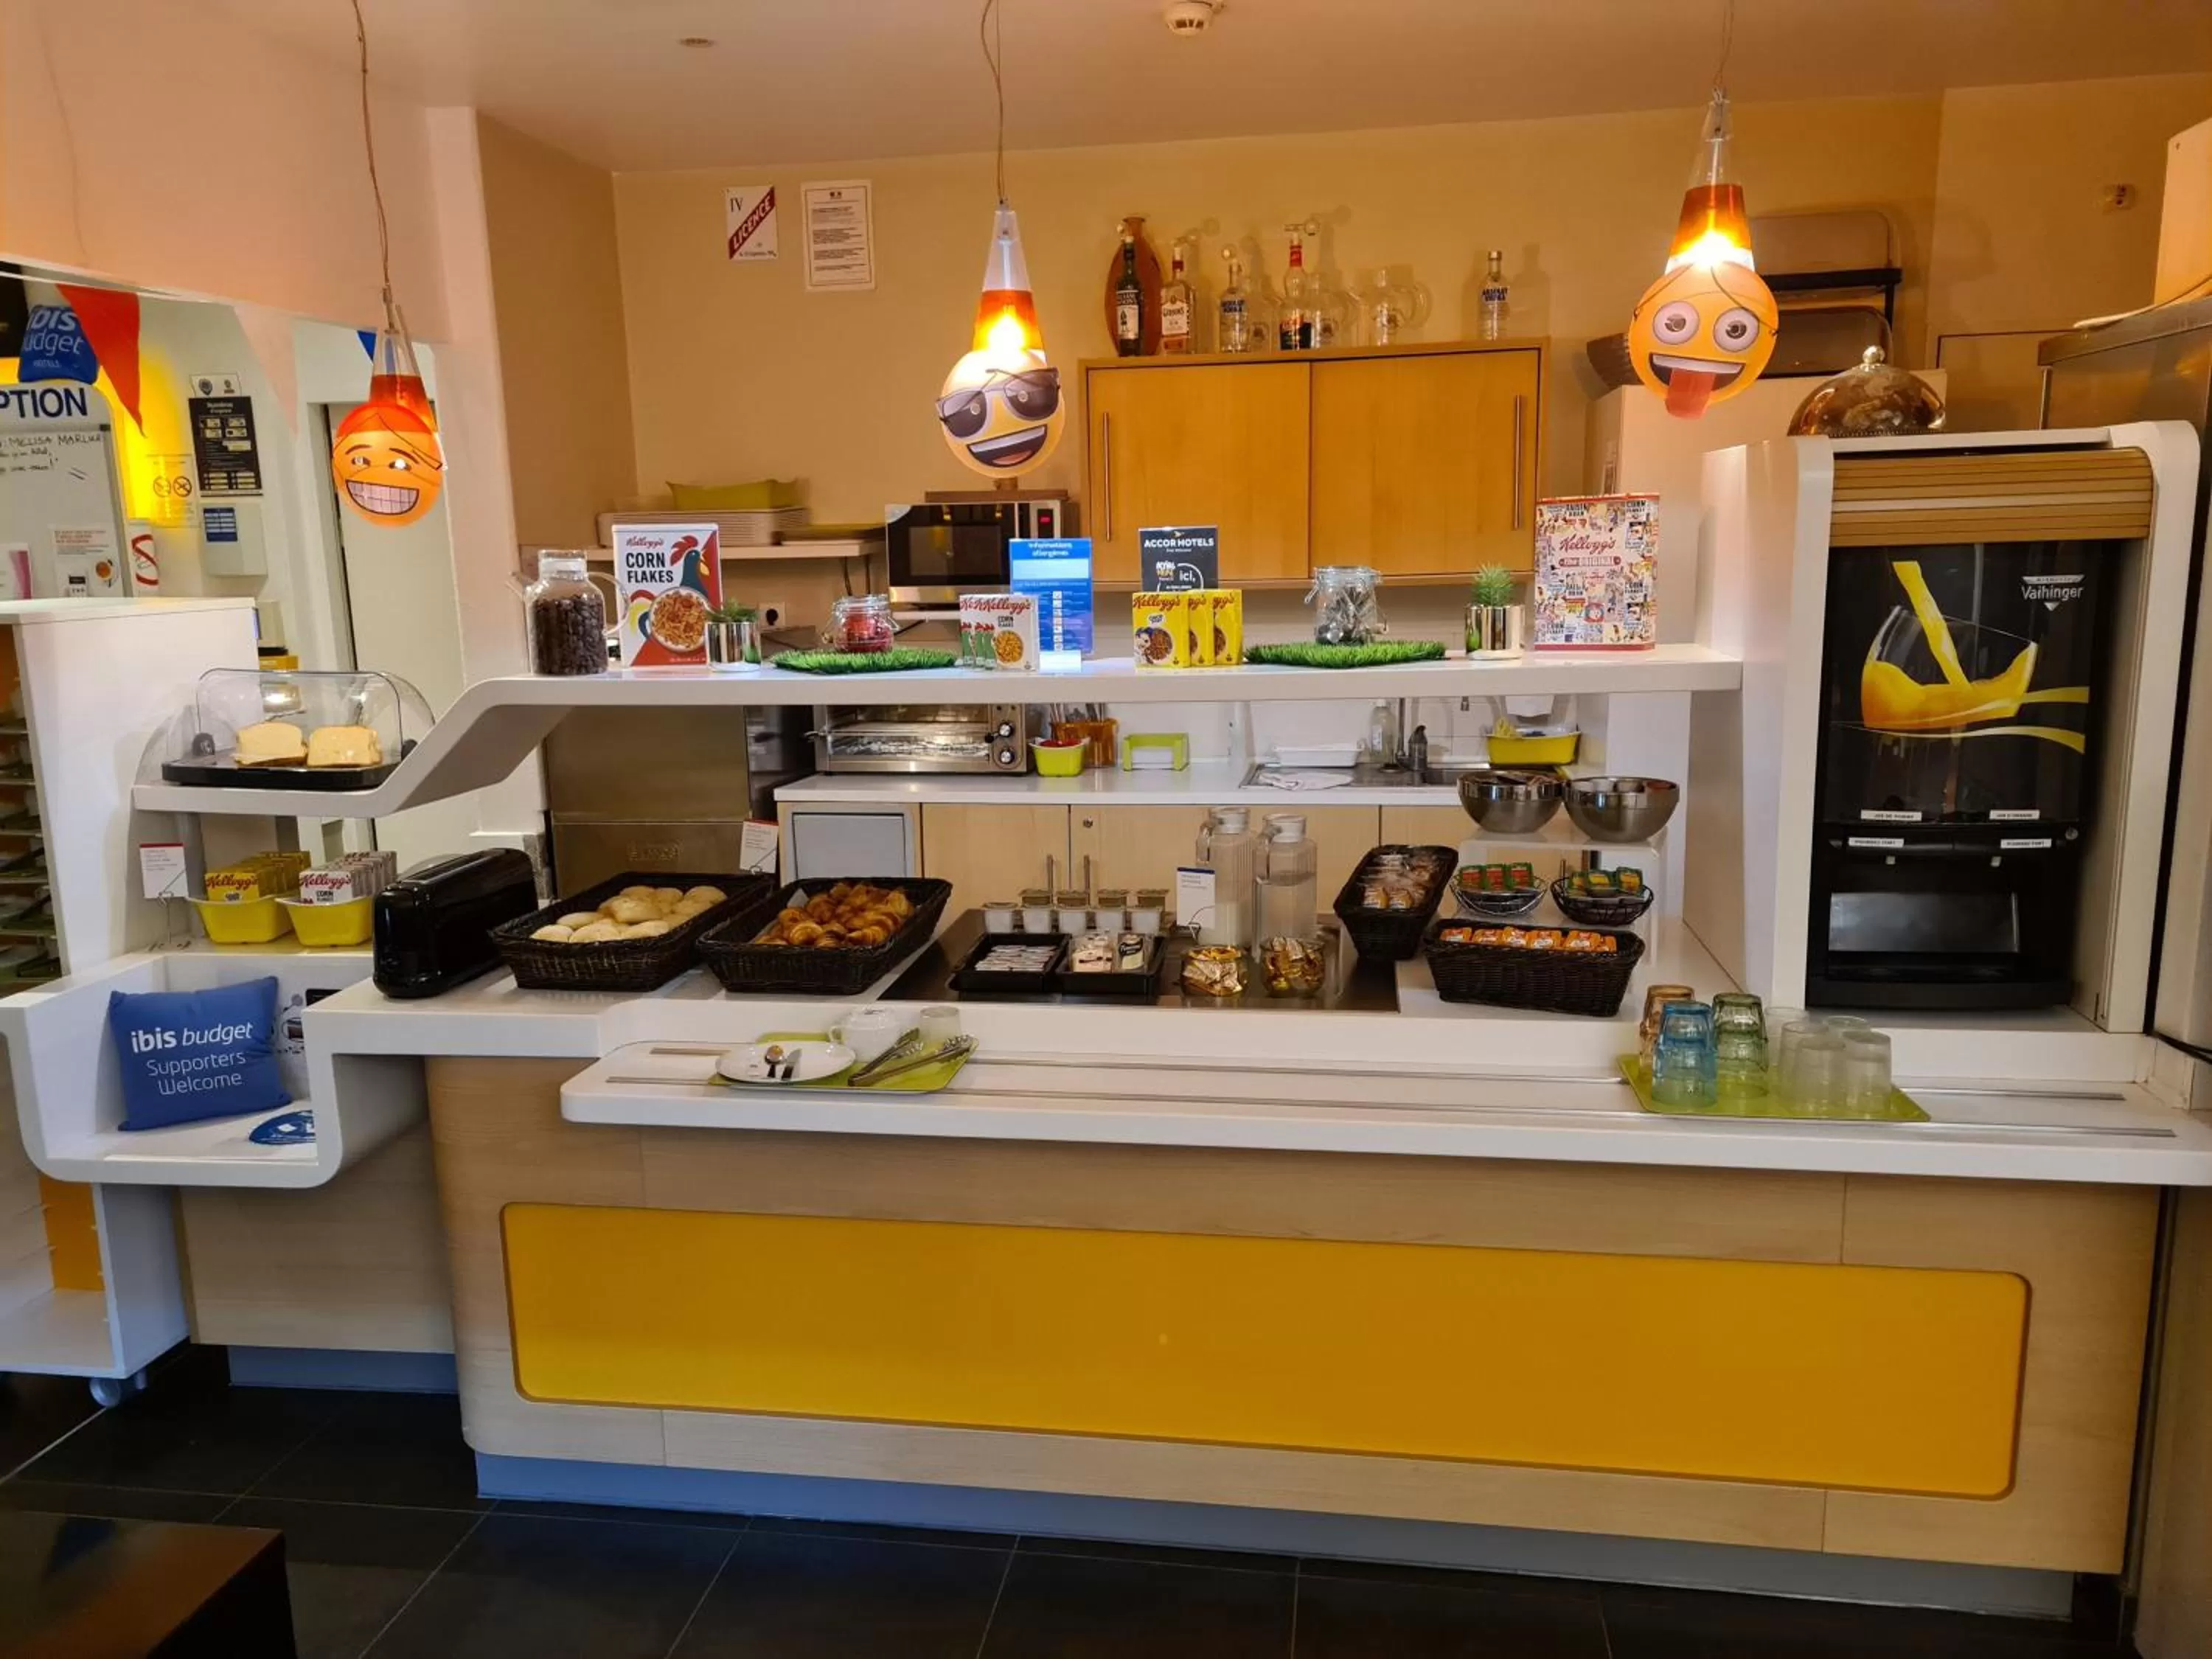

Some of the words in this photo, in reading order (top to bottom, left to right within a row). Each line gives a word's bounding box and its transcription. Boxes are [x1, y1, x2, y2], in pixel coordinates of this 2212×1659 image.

[730, 198, 743, 212] IV
[733, 195, 771, 250] LICENCE
[24, 327, 84, 357] udget
[0, 388, 88, 418] PTION
[1144, 539, 1177, 548] ACCOR
[1178, 538, 1215, 547] HOTELS
[1559, 533, 1616, 554] Kellogg's
[626, 552, 666, 568] CORN
[627, 570, 674, 583] FLAKES
[2021, 585, 2084, 602] Vaihinger
[983, 597, 1031, 615] Kellogg's
[1133, 594, 1180, 611] Kellogg's
[206, 874, 258, 891] Kellogg's
[301, 873, 352, 890] Kellogg's
[131, 1027, 178, 1054] ibis
[182, 1022, 254, 1046] budget
[147, 1051, 246, 1077] Supporters
[158, 1073, 243, 1096] Welcome
